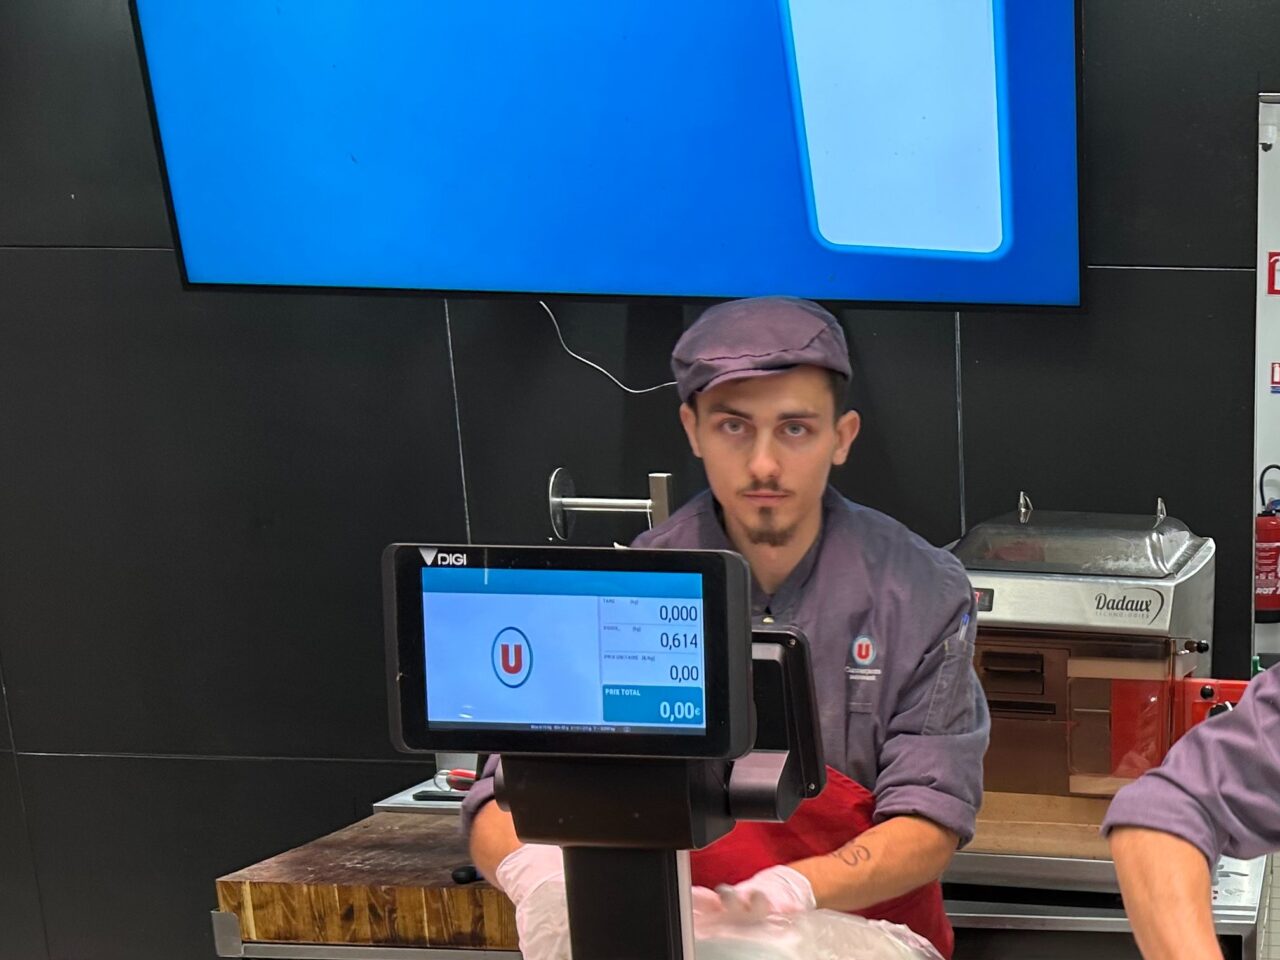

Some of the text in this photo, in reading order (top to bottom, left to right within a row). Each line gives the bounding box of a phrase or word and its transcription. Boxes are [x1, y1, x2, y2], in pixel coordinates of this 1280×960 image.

[437, 553, 467, 566] DIGI
[1095, 593, 1151, 612] Dadaux
[659, 605, 698, 623] 0,000
[660, 632, 698, 650] 0,614
[501, 643, 523, 674] U
[857, 643, 871, 660] U
[670, 665, 699, 683] 0,00
[605, 688, 620, 696] PRIX
[659, 701, 694, 722] 0,00
